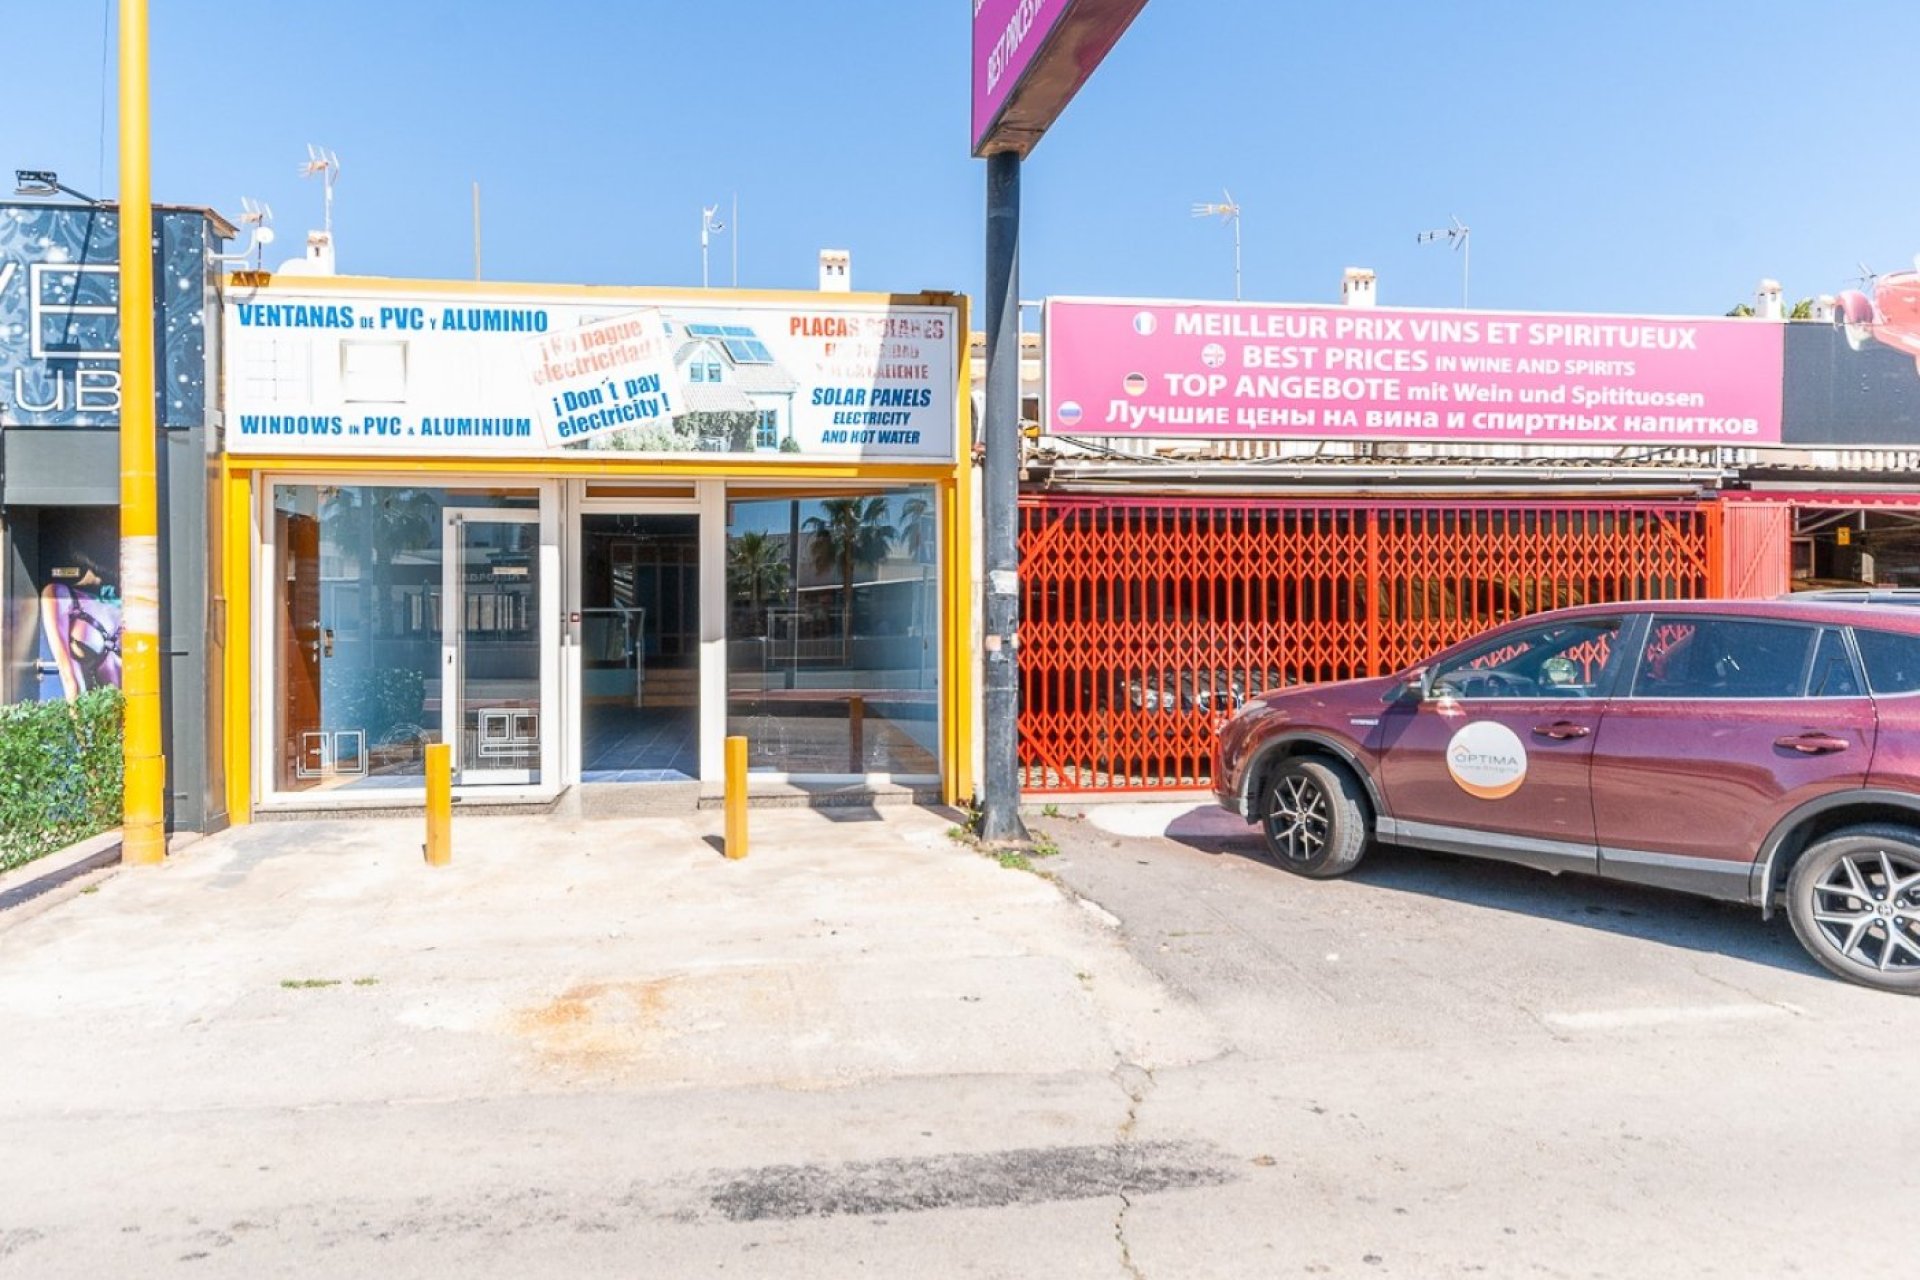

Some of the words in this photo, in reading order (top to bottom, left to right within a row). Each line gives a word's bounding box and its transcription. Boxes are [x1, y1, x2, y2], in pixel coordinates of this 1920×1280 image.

[0, 263, 121, 359] E
[238, 303, 354, 328] VENTANAS
[360, 316, 374, 329] DE
[380, 307, 424, 330] PVC
[430, 317, 437, 330] Y
[442, 309, 548, 332] ALUMINIO
[580, 320, 643, 352] pague
[789, 316, 860, 337] PLACAS
[1175, 312, 1328, 339] MEILLEUR
[1335, 316, 1404, 341] PRIX
[1410, 319, 1480, 343] VINS
[1487, 322, 1522, 344] ET
[1528, 323, 1697, 350] SPIRITUEUX
[1243, 345, 1319, 368] BEST
[1325, 348, 1429, 372] PRICES
[1436, 357, 1457, 371] IN
[1461, 357, 1511, 373] WINE
[1516, 358, 1560, 374] AND
[1565, 359, 1635, 376] SPIRITS
[0, 369, 121, 411] UB
[624, 373, 661, 399] pay
[811, 387, 867, 405] SOLAR
[870, 388, 932, 407] PANELS
[1164, 373, 1228, 397] TOP
[1235, 375, 1400, 400] ANGEBOTE
[1408, 382, 1448, 402] mit
[1454, 383, 1512, 402] Wein
[1519, 385, 1566, 404] und
[1572, 385, 1705, 409] Spitituosen
[240, 415, 342, 435] WINDOWS
[349, 425, 360, 435] IN
[364, 416, 401, 436] PVC
[408, 427, 415, 436] &
[421, 417, 531, 436] ALUMINIUM
[833, 411, 912, 426] ELECTRICITY
[1446, 412, 1465, 428] и
[1472, 412, 1617, 435] спиртных
[1623, 415, 1760, 435] напитков
[821, 430, 847, 444] AND
[850, 430, 877, 444] HOT
[877, 430, 920, 444] WATER
[1454, 753, 1519, 766] OPTIMA
